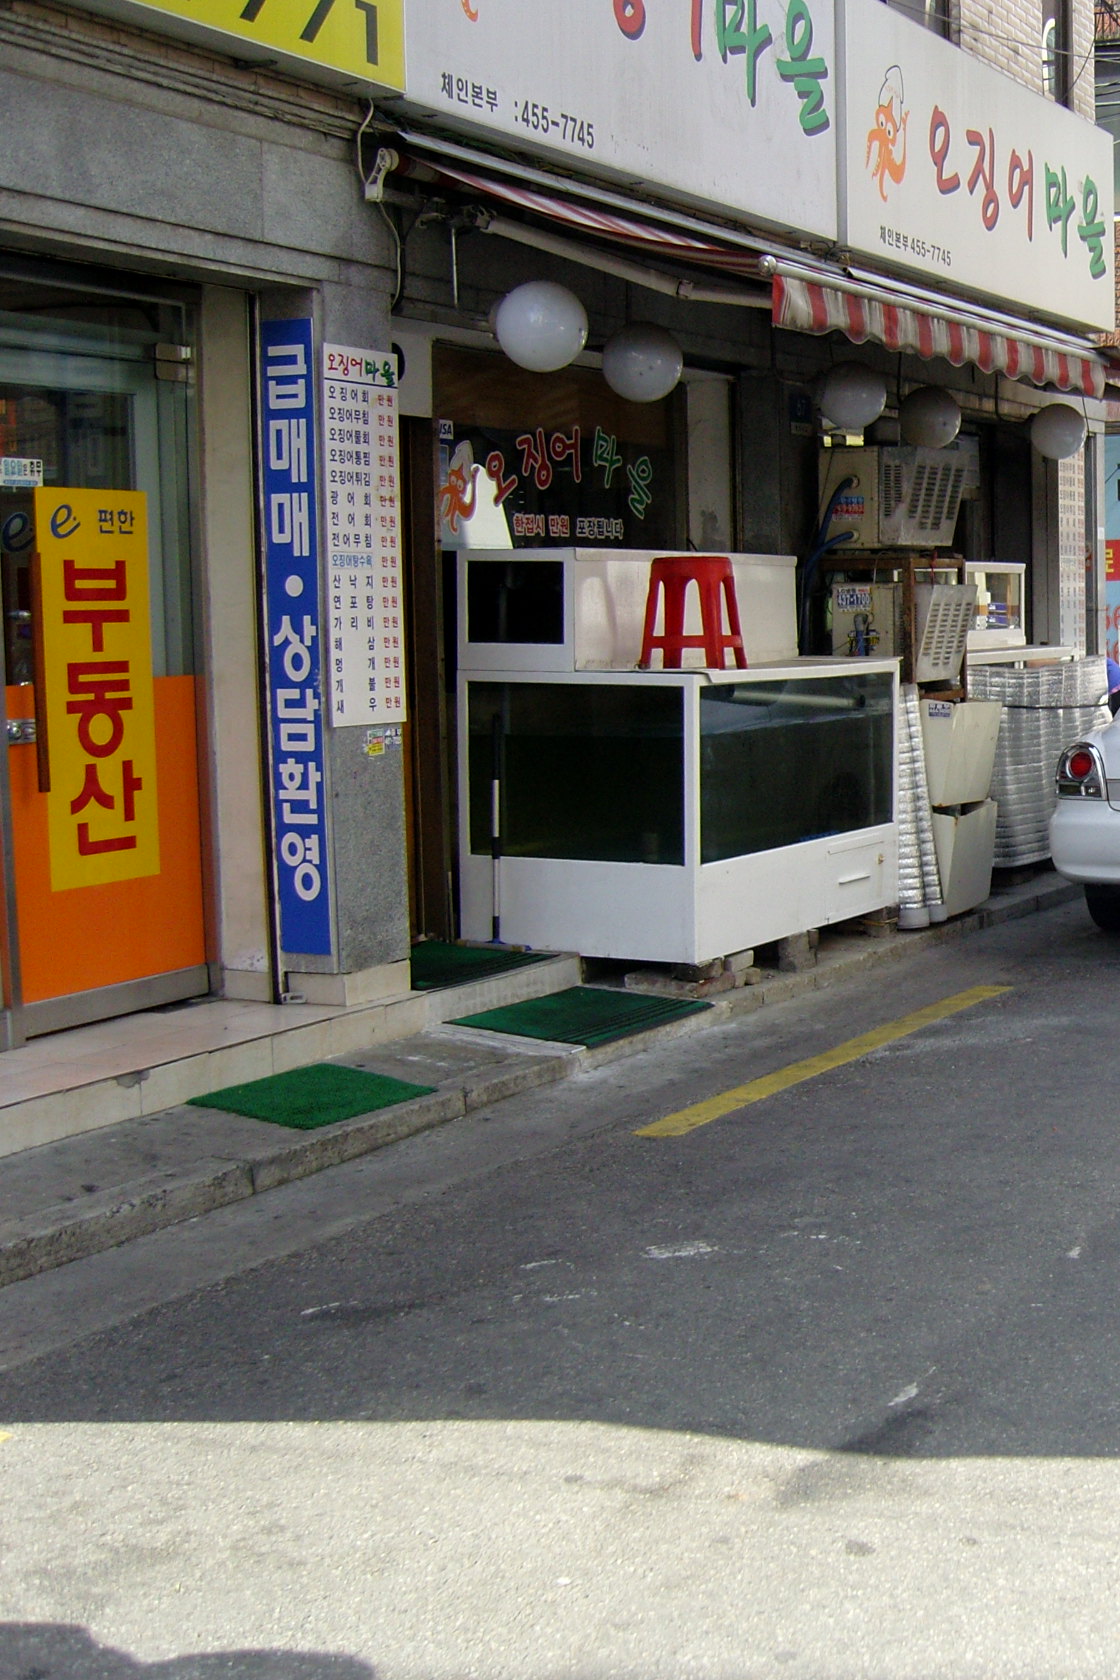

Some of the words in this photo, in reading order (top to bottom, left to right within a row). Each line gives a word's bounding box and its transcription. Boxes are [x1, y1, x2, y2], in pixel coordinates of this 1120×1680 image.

[441, 71, 499, 113] 체인본부
[880, 225, 909, 251] 체인본부
[910, 235, 952, 267] 455-7745
[329, 385, 370, 405] 오징어회
[329, 407, 369, 425] 오징어무침
[329, 428, 370, 446] 오징어물회
[330, 470, 371, 487] 오징어튀김
[98, 509, 135, 535] 편한
[513, 513, 545, 537] 한접시
[548, 514, 570, 537] 만원
[63, 560, 142, 856] 부동산
[273, 615, 321, 900] 상담환영
